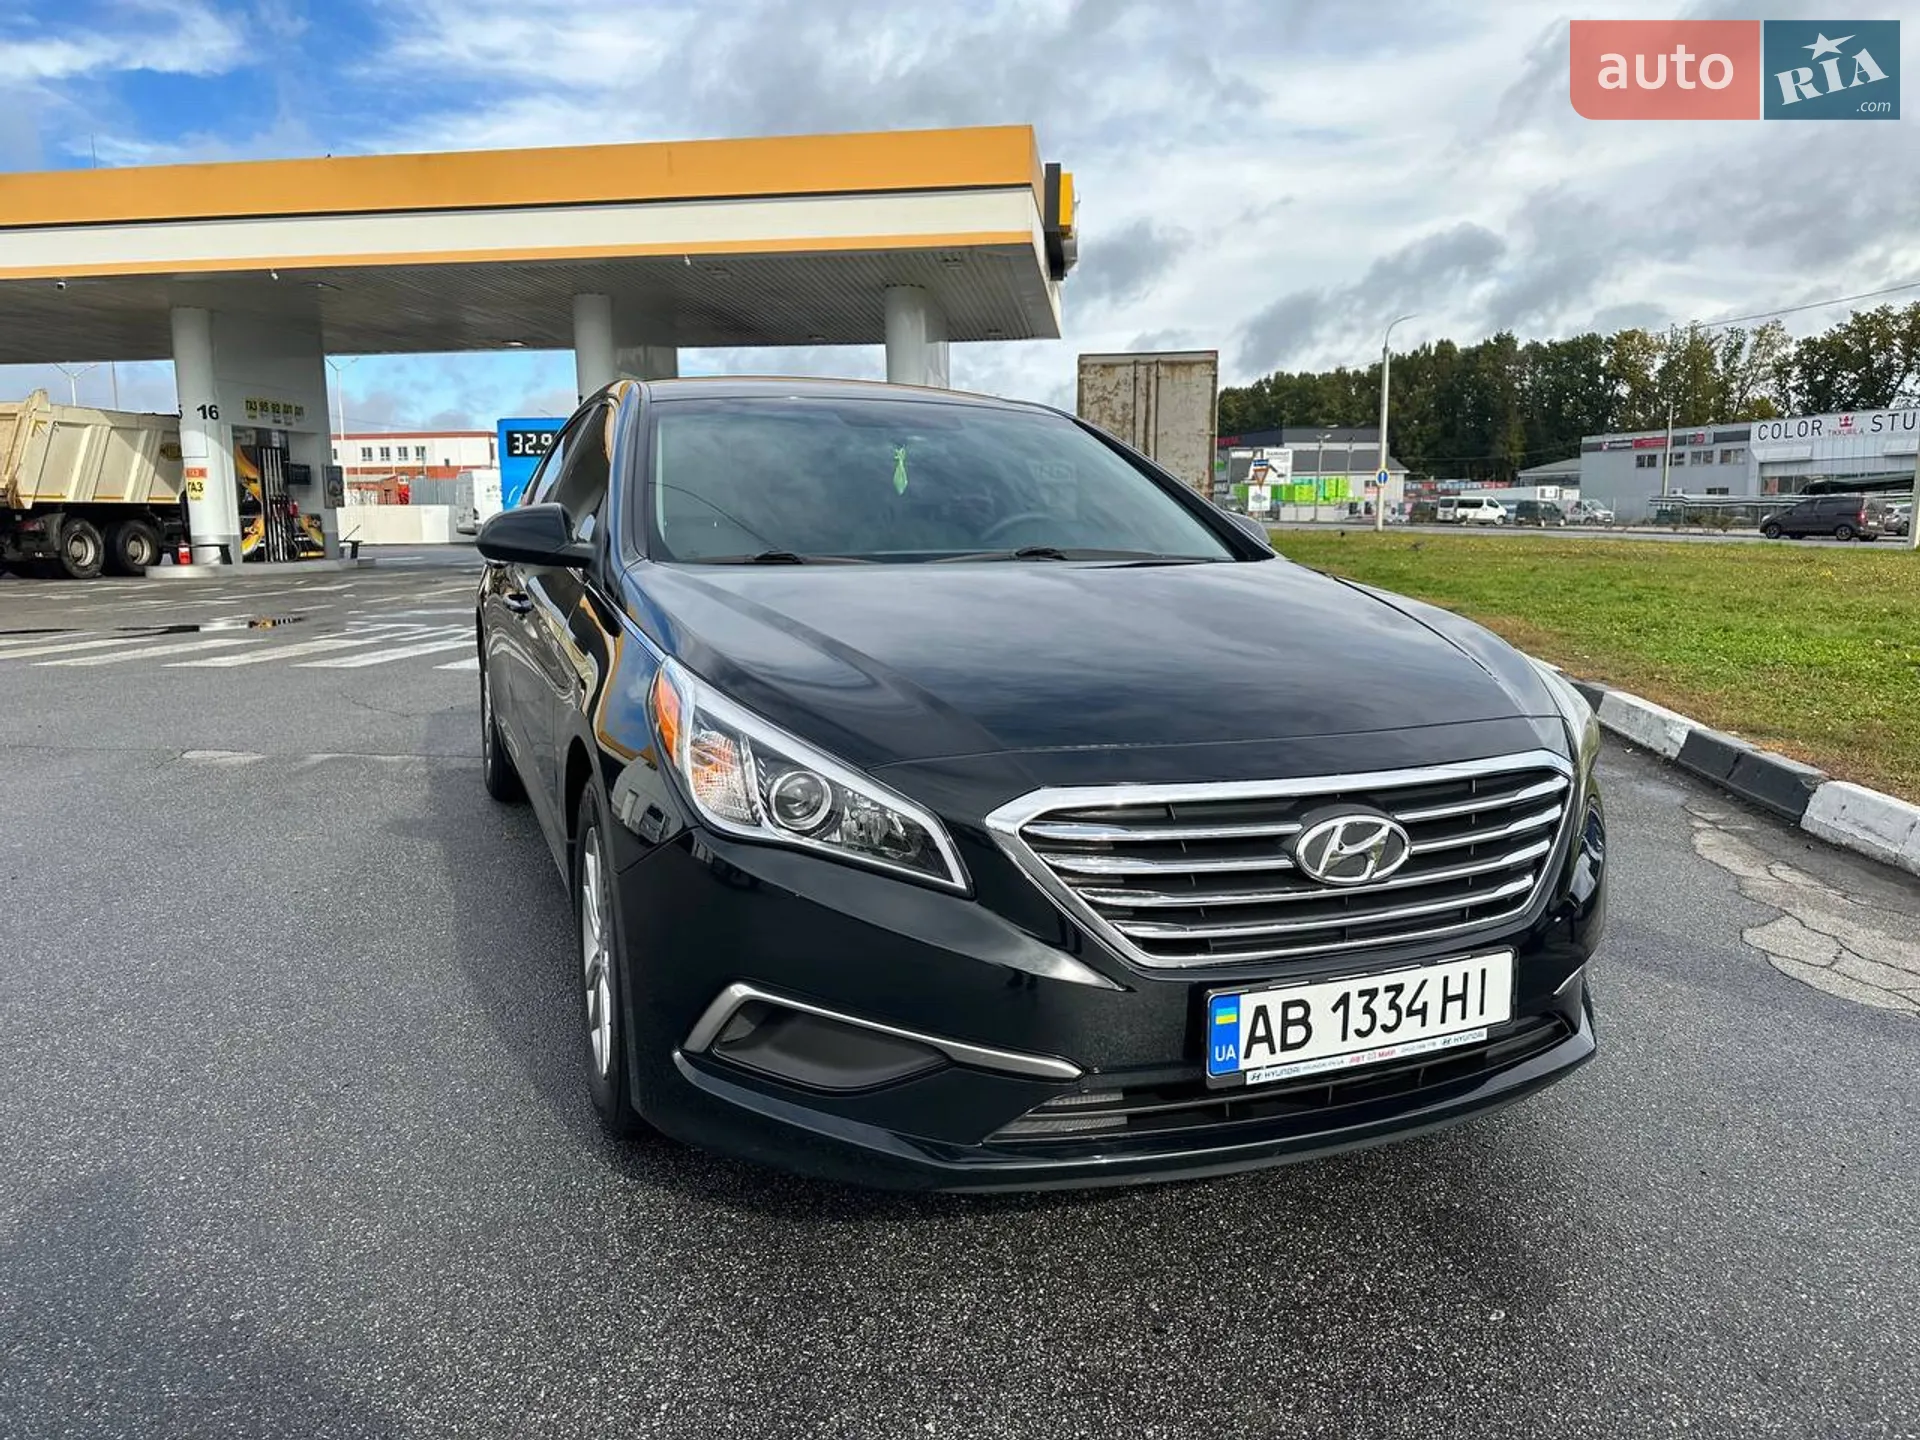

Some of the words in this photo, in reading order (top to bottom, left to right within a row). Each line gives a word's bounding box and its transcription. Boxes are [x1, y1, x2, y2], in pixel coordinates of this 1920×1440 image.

[197, 404, 219, 420] 16
[1758, 419, 1823, 441] COLOR
[1871, 412, 1916, 433] STU
[187, 481, 204, 492] ГАЗ
[1243, 998, 1313, 1060] AB
[1331, 978, 1429, 1042] 1334
[1214, 1045, 1237, 1063] UA
[1264, 1066, 1302, 1078] HYUNDAI
